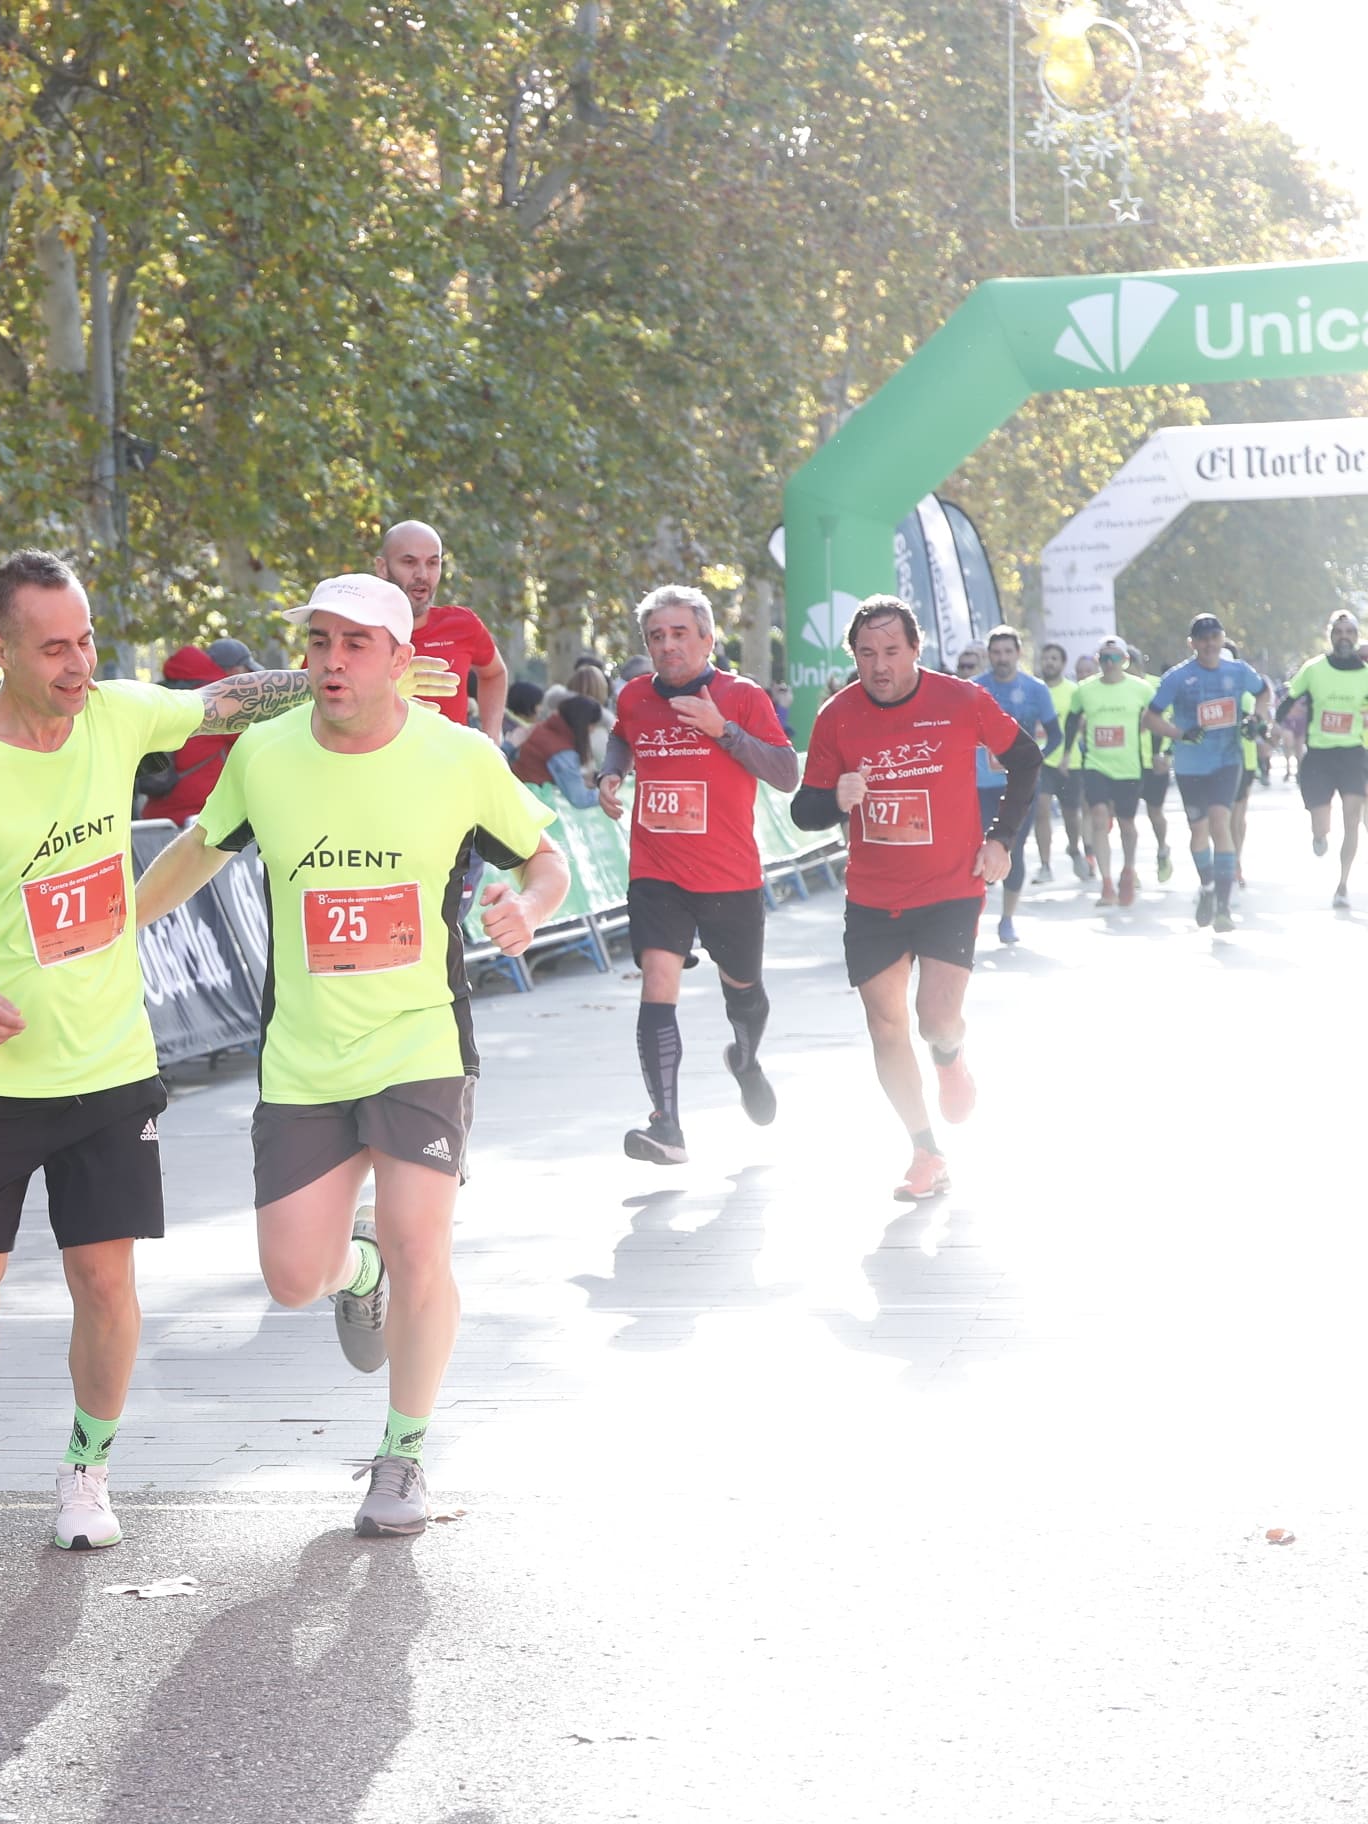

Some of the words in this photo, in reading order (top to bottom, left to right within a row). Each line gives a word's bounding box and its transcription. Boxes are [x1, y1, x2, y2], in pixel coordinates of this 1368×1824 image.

[1195, 295, 1368, 360] Unic
[1196, 446, 1235, 481] El
[1244, 444, 1327, 478] Norte
[1333, 443, 1365, 474] de
[669, 747, 711, 757] Santander
[897, 764, 944, 779] Santander
[647, 791, 679, 814] 428
[868, 801, 900, 825] 427
[21, 814, 115, 875] ADIENT
[291, 841, 403, 875] ADIENT
[51, 885, 86, 930] 27
[327, 905, 368, 943] 25
[422, 1147, 452, 1162] adidas
